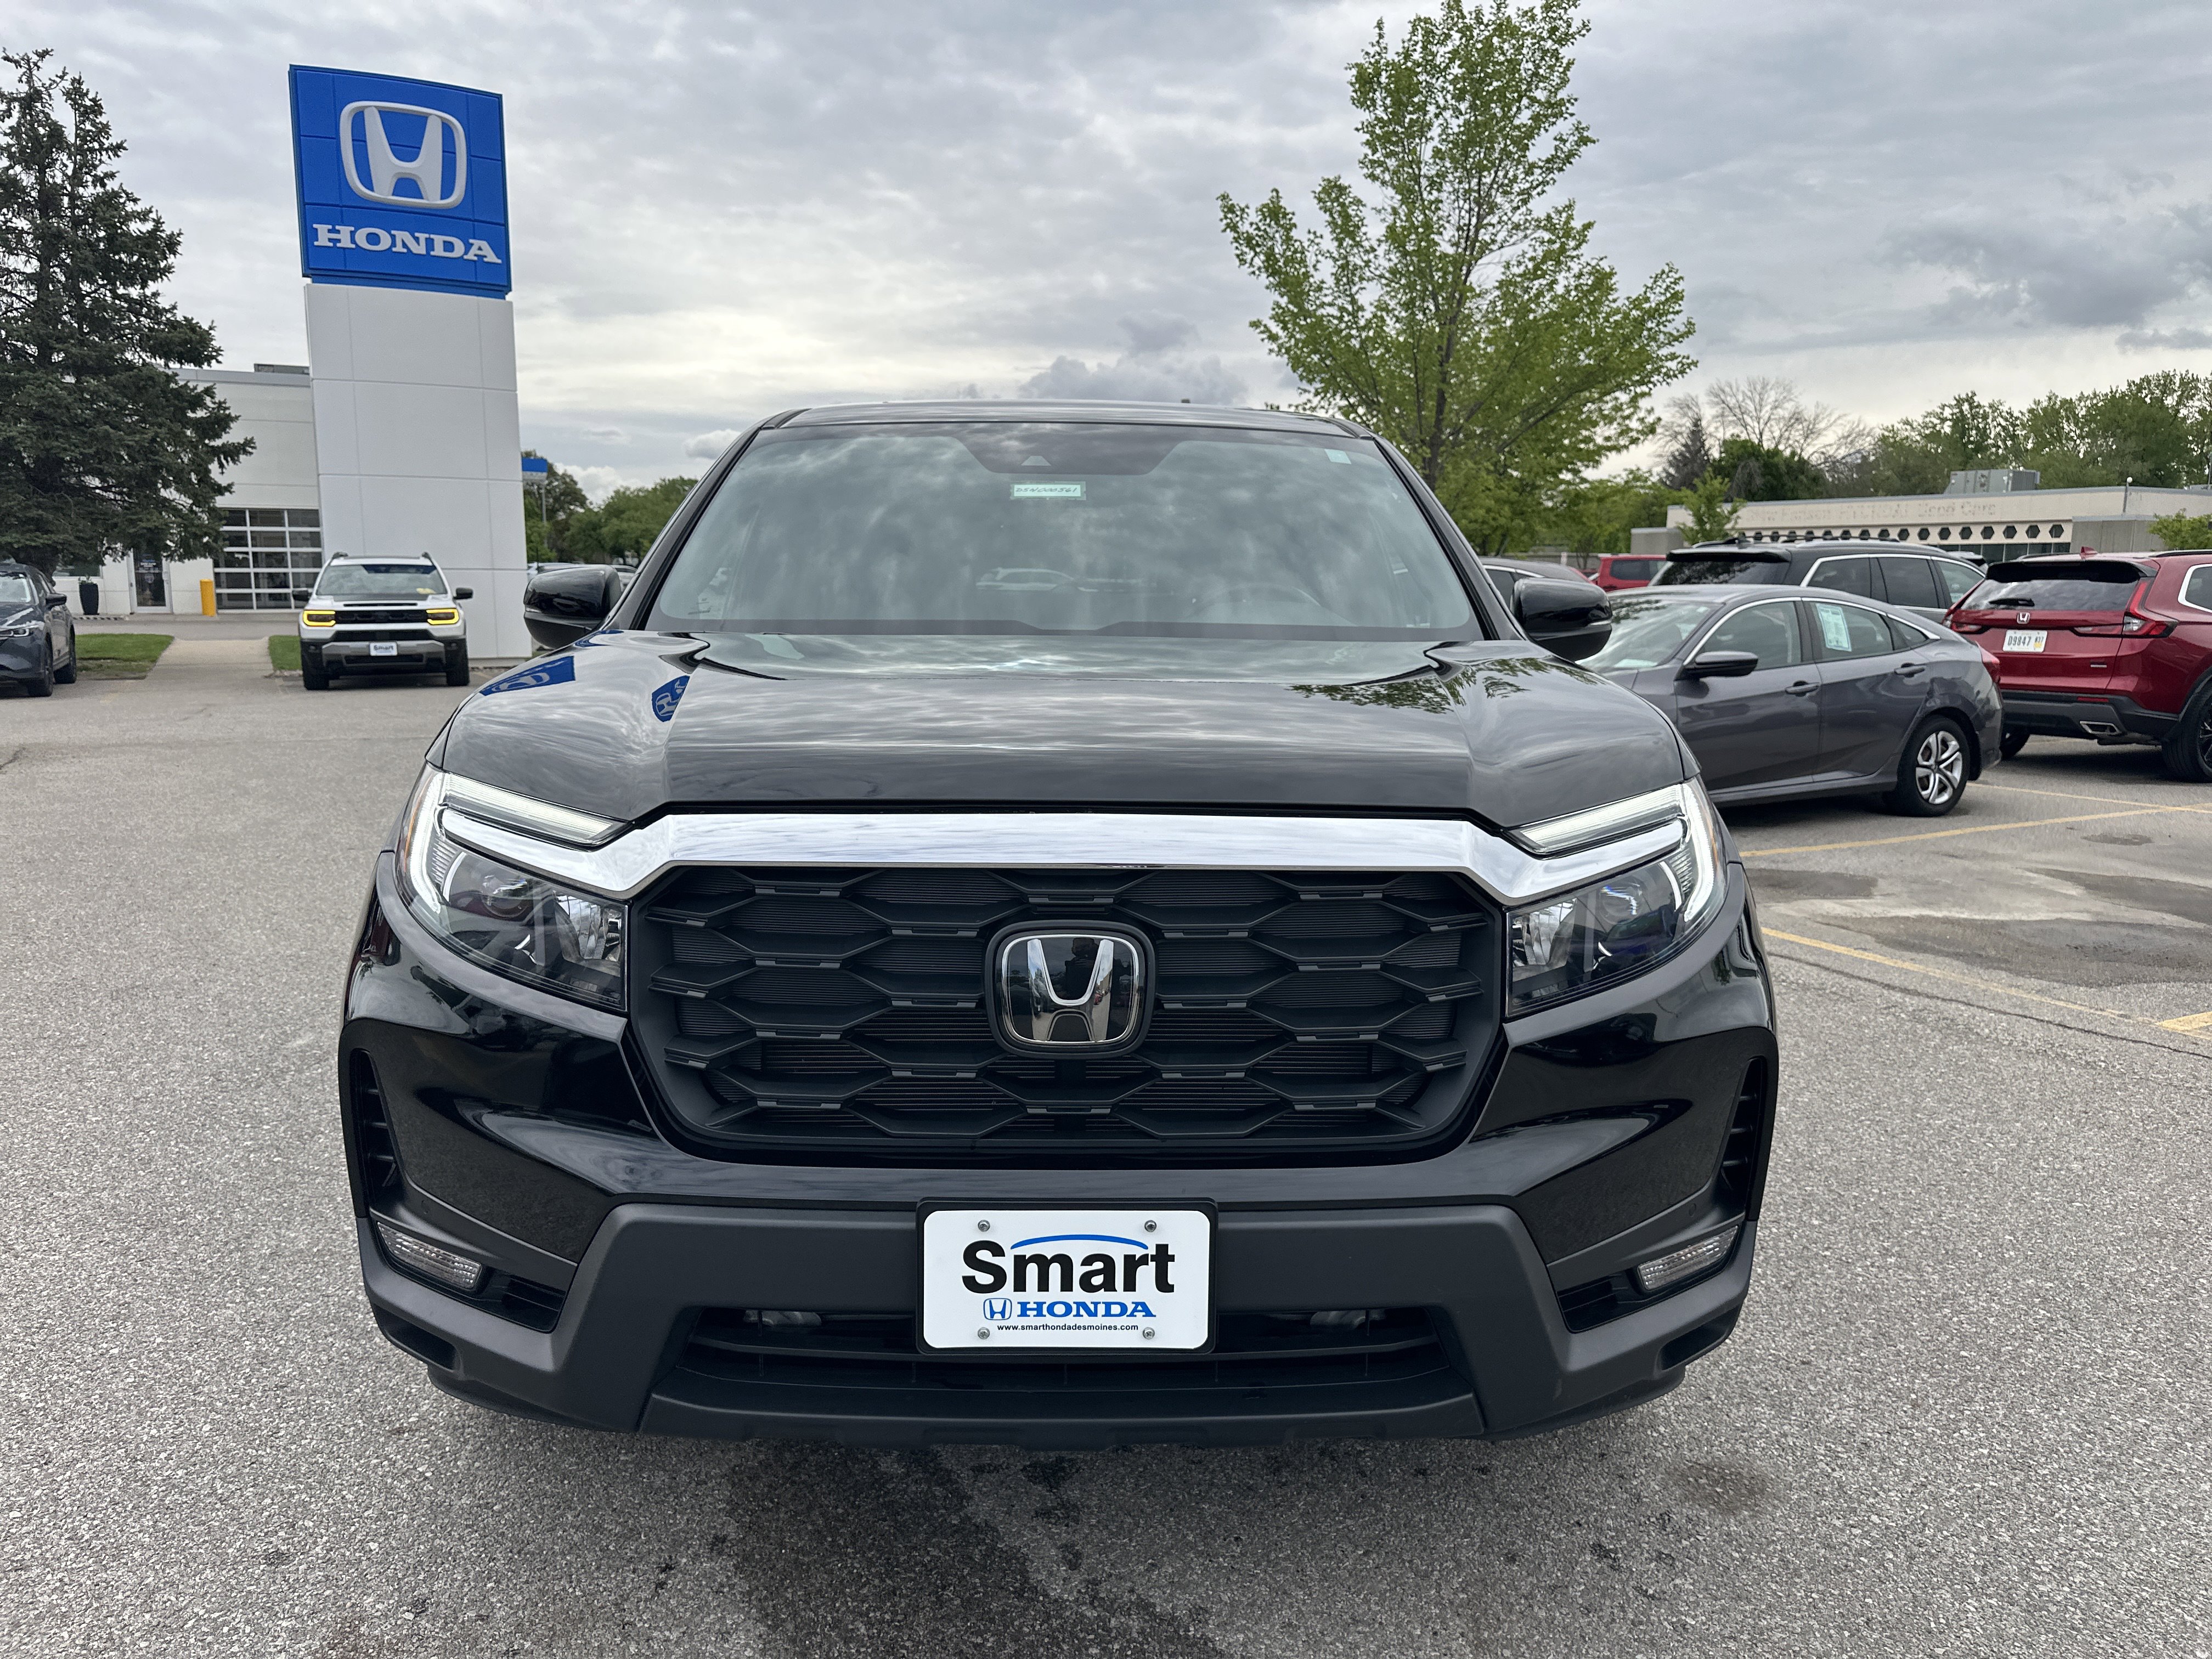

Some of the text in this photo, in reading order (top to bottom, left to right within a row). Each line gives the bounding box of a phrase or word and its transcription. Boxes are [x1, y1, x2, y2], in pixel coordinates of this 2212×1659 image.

[312, 224, 501, 263] HONDA
[962, 1240, 1175, 1294] Smart
[1017, 1301, 1156, 1317] HONDA
